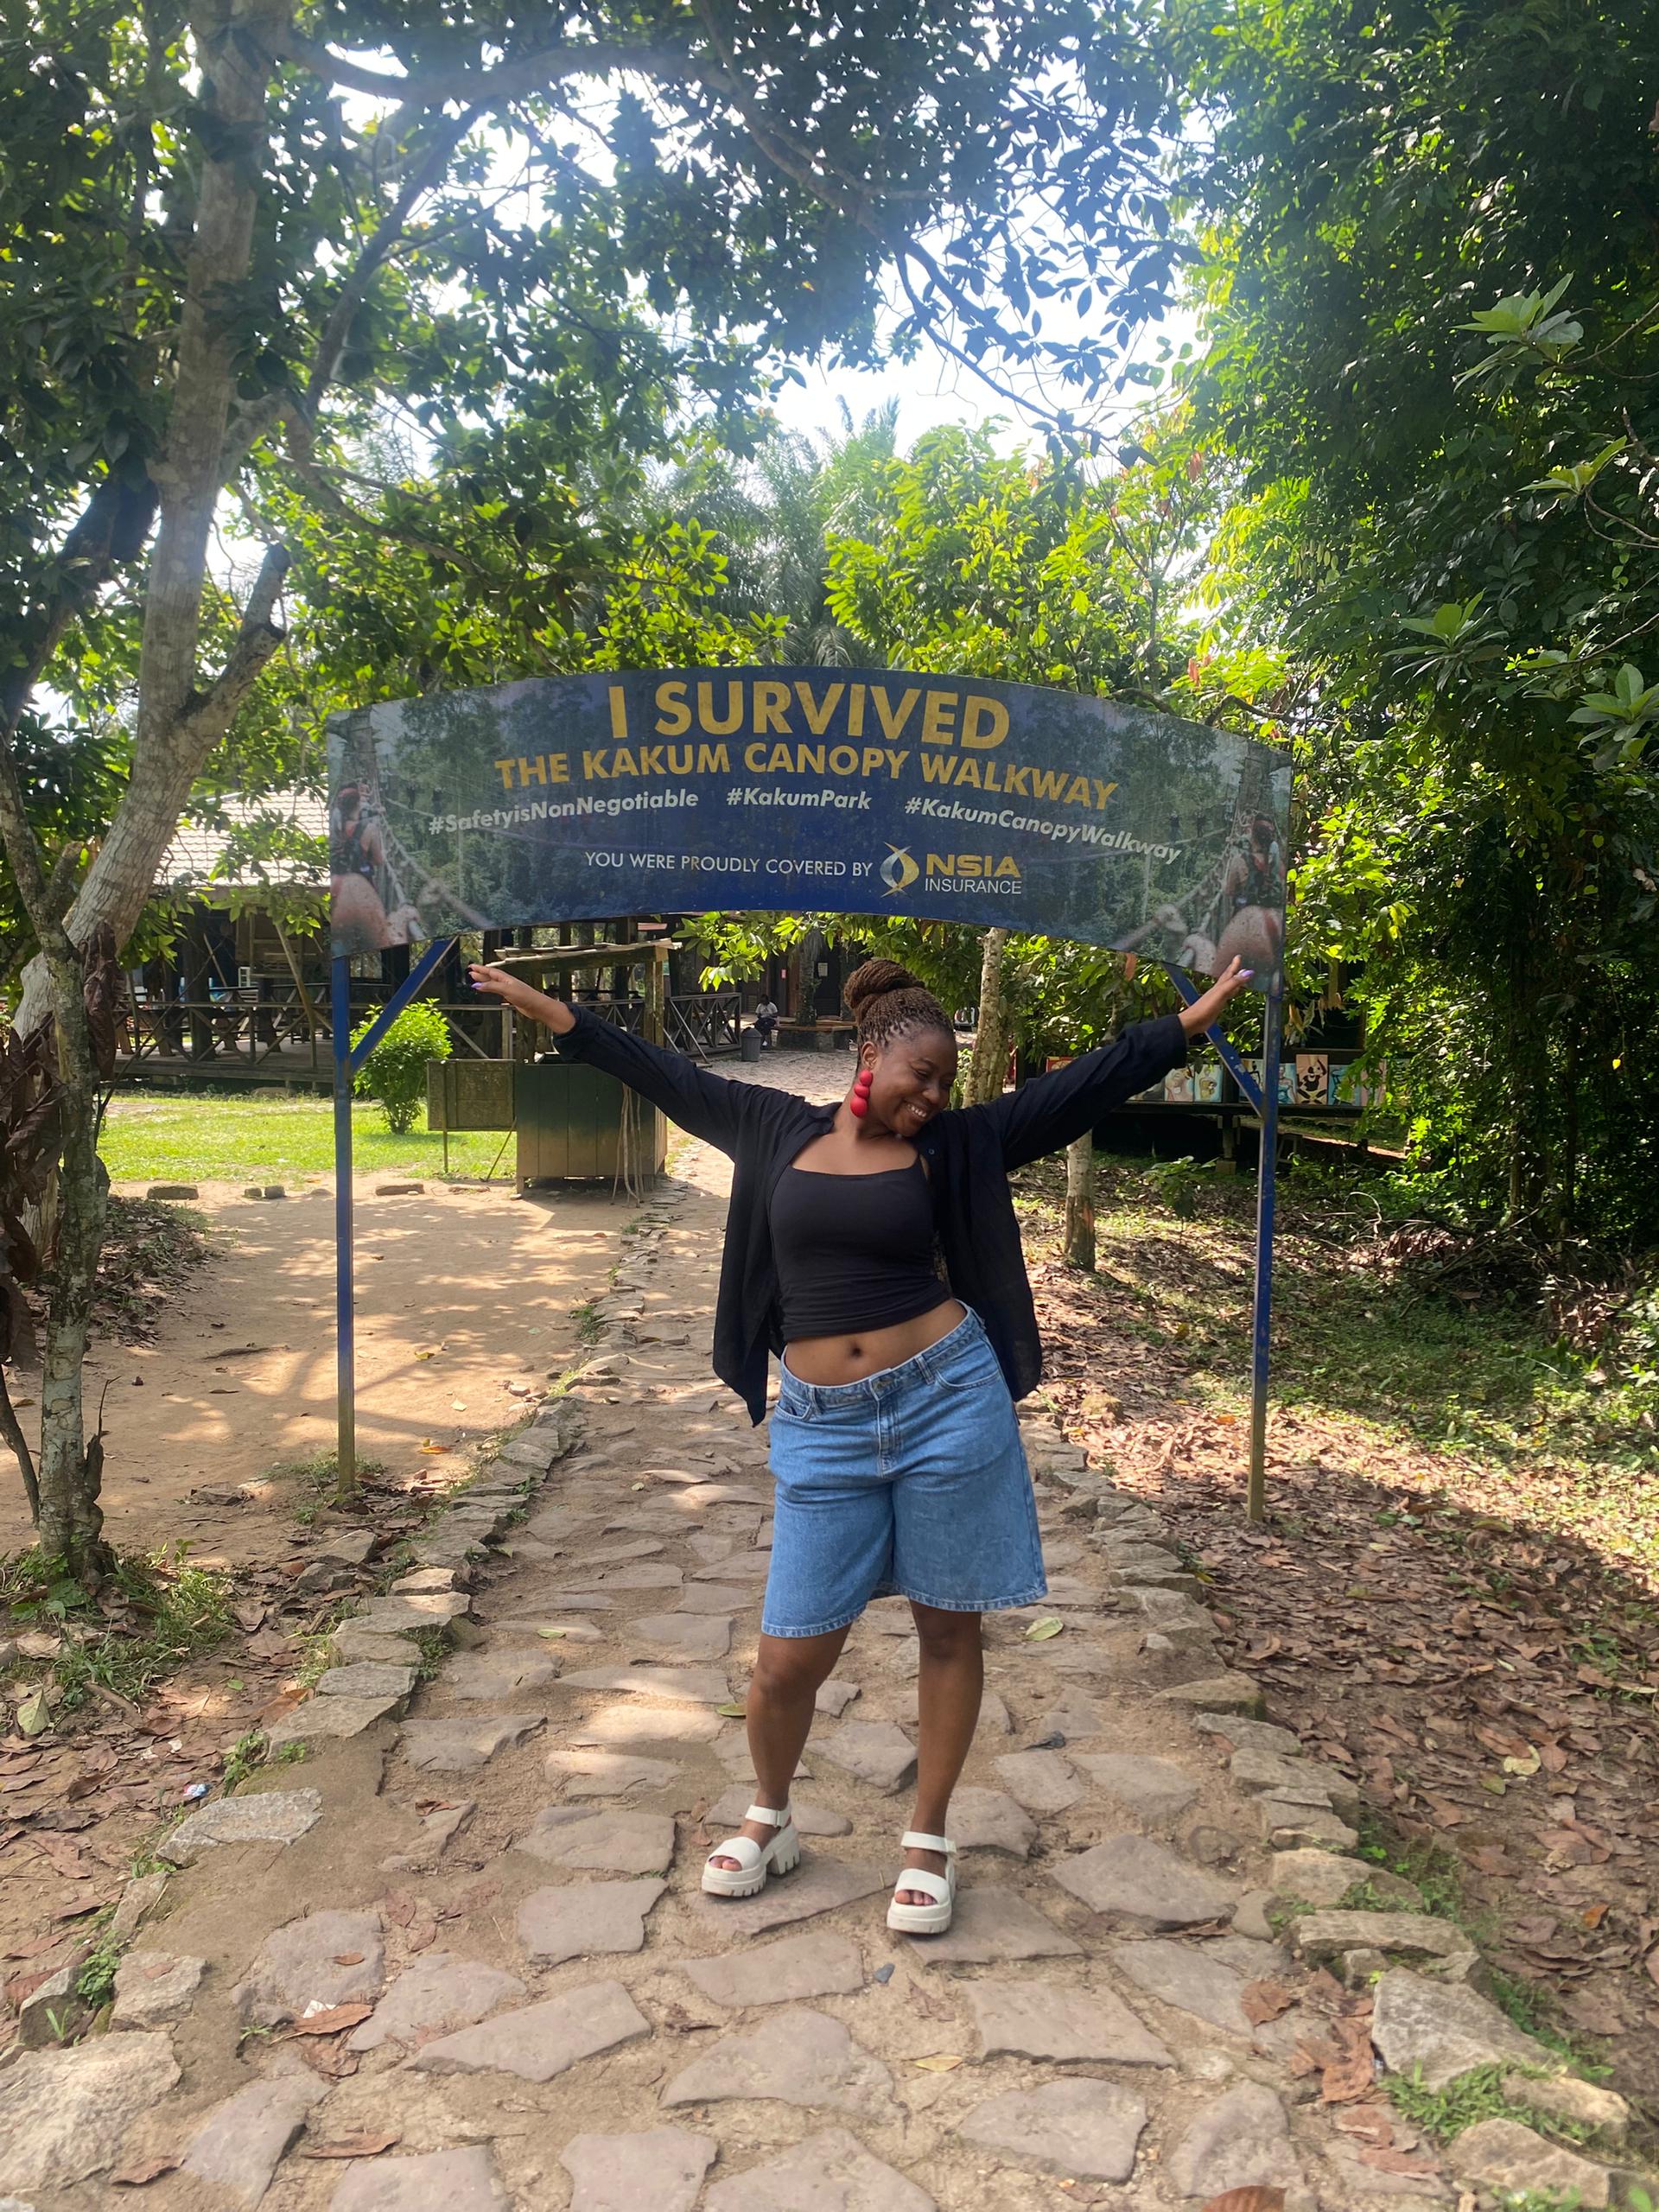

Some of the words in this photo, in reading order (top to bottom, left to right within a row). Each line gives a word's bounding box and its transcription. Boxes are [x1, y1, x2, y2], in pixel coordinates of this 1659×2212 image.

[609, 686, 627, 738] I
[655, 681, 1009, 749] SURVIVED
[495, 753, 569, 788] THE
[582, 744, 730, 779] KAKUM
[744, 743, 909, 779] CANOPY
[921, 753, 1118, 810] WALKWAY
[429, 790, 699, 835] #SafetyisNonNegotiable
[727, 788, 871, 810] #KakumPark
[905, 797, 1182, 864] #KakumCanopyWalkway
[586, 852, 623, 868] YOU
[630, 854, 675, 869] WERE
[682, 856, 759, 873] PROUDLY
[766, 859, 847, 876] COVERED
[852, 861, 873, 877] BY
[925, 879, 1022, 895] INSURANCE
[926, 853, 1021, 878] NSIA
